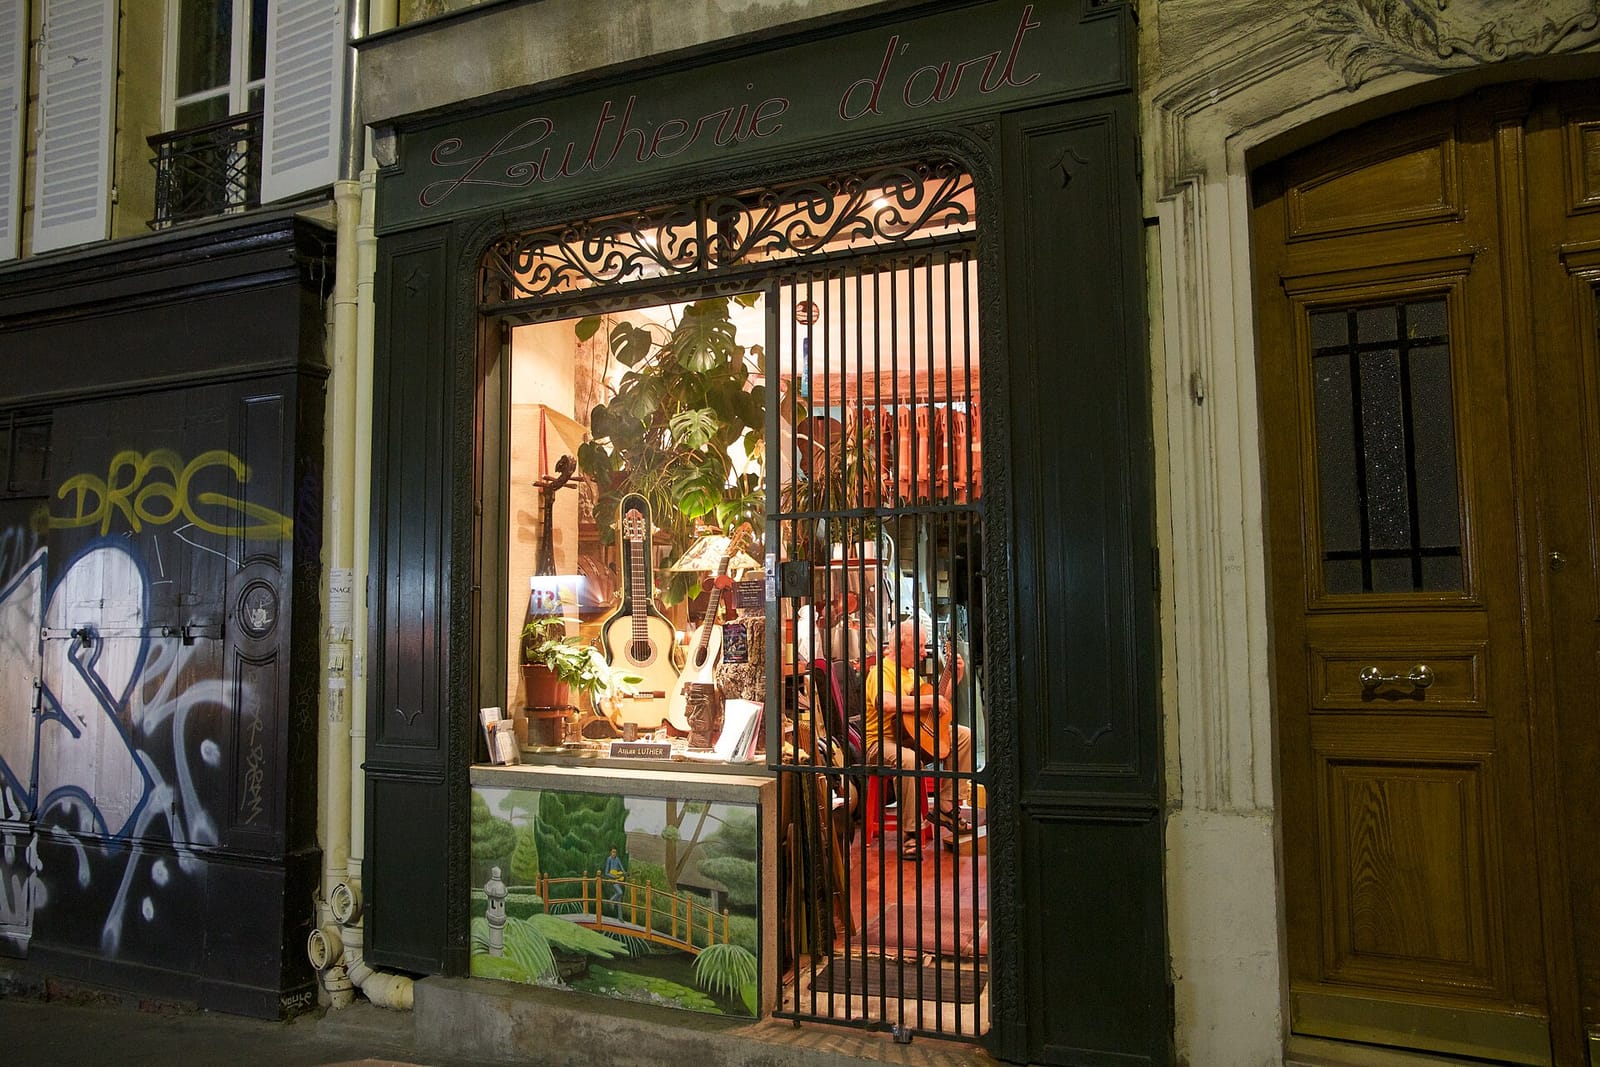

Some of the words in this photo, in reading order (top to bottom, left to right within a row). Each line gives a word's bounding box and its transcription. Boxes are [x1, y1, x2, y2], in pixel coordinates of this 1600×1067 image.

[419, 84, 790, 208] Lutherie
[838, 4, 1041, 121] d'art
[637, 748, 664, 756] LUTHIER
